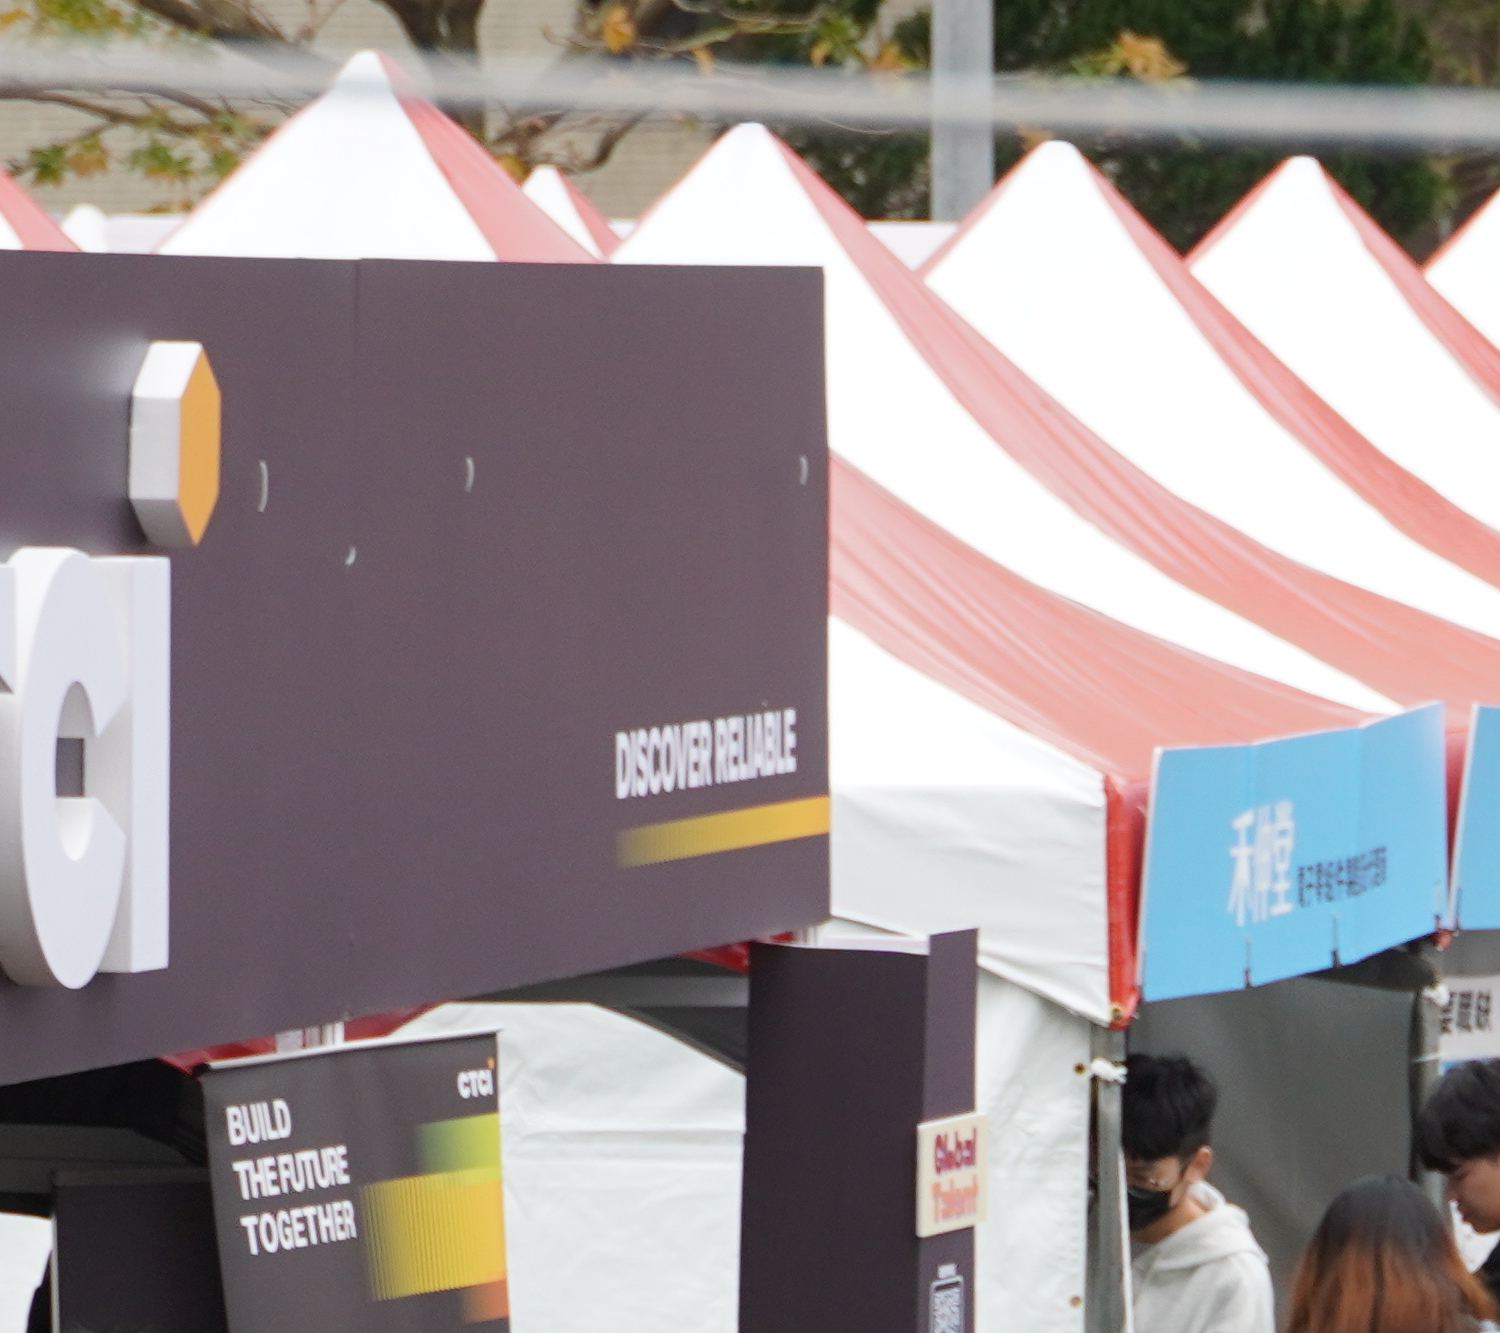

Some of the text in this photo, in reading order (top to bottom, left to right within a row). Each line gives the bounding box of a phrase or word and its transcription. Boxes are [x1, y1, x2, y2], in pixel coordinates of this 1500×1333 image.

[615, 708, 798, 799] DISCOVER RELIABLE
[456, 1069, 494, 1099] CTCI
[225, 1100, 292, 1147] BUILD
[232, 1145, 351, 1201] THE FUTURE
[240, 1200, 358, 1257] TOGETHER
